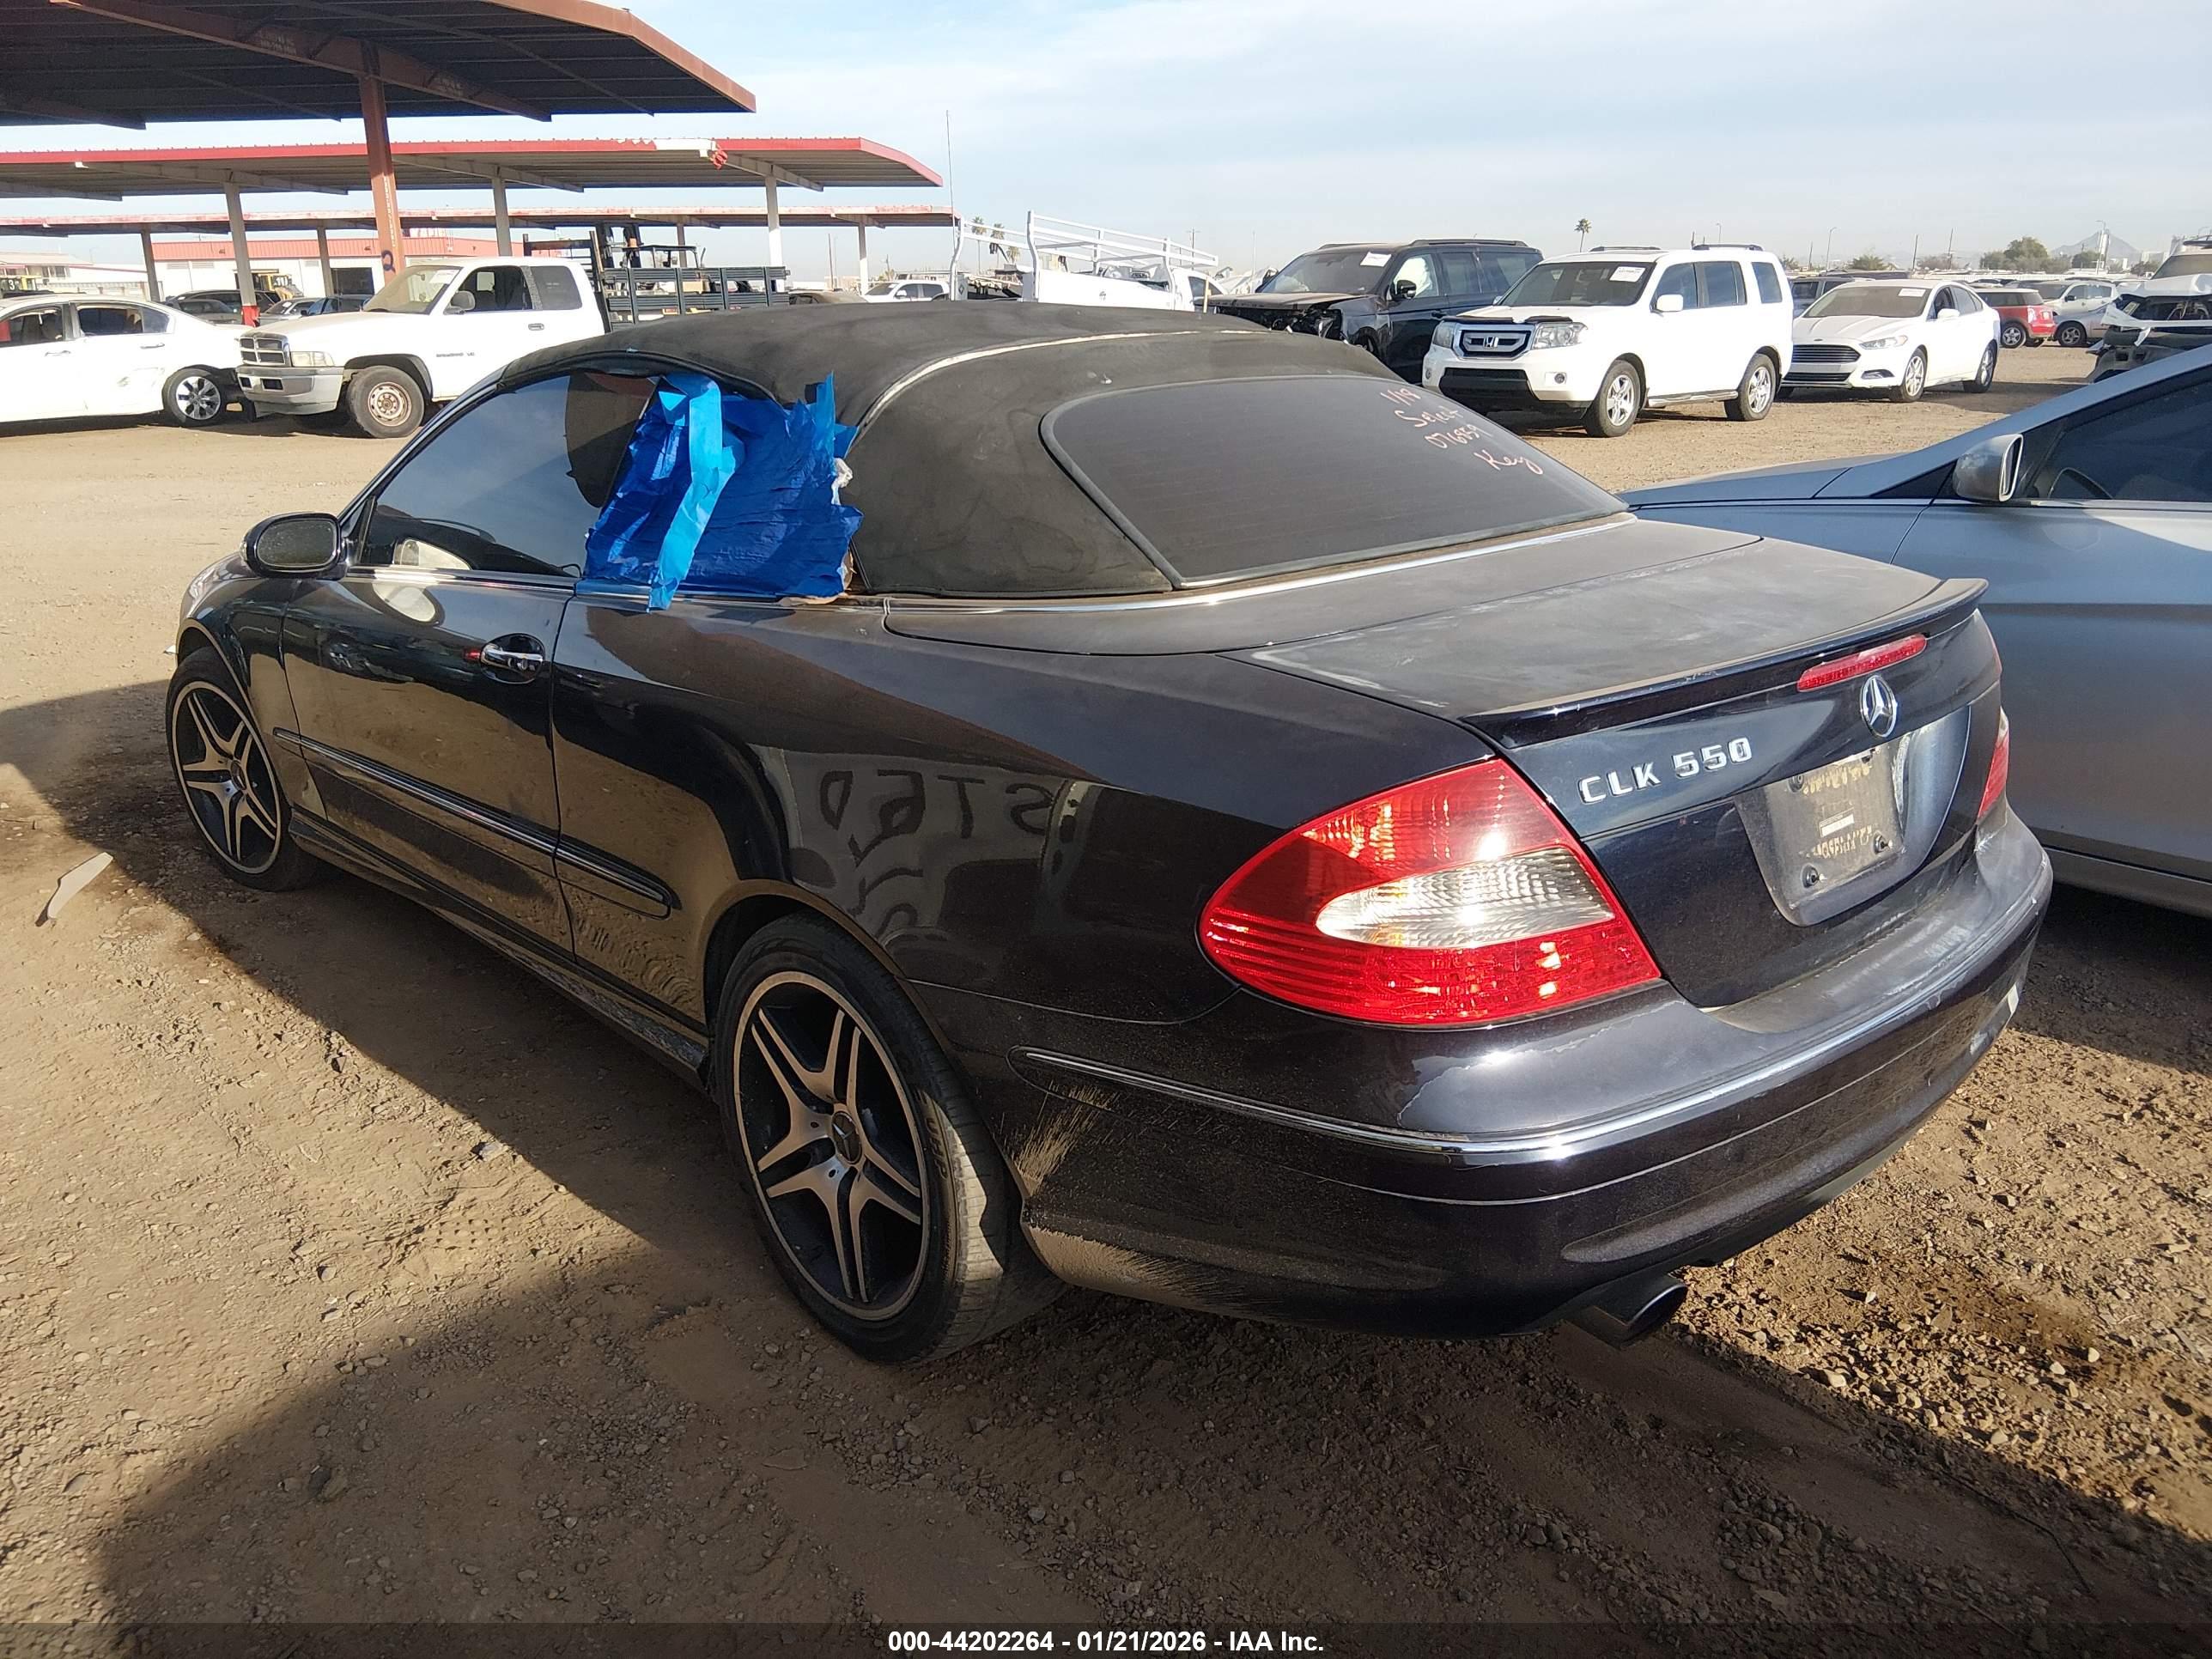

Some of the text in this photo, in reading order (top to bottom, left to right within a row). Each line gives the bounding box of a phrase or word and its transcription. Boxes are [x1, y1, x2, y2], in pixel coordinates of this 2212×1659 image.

[1474, 449, 1544, 476] Key
[1578, 737, 1753, 804] CLK 550
